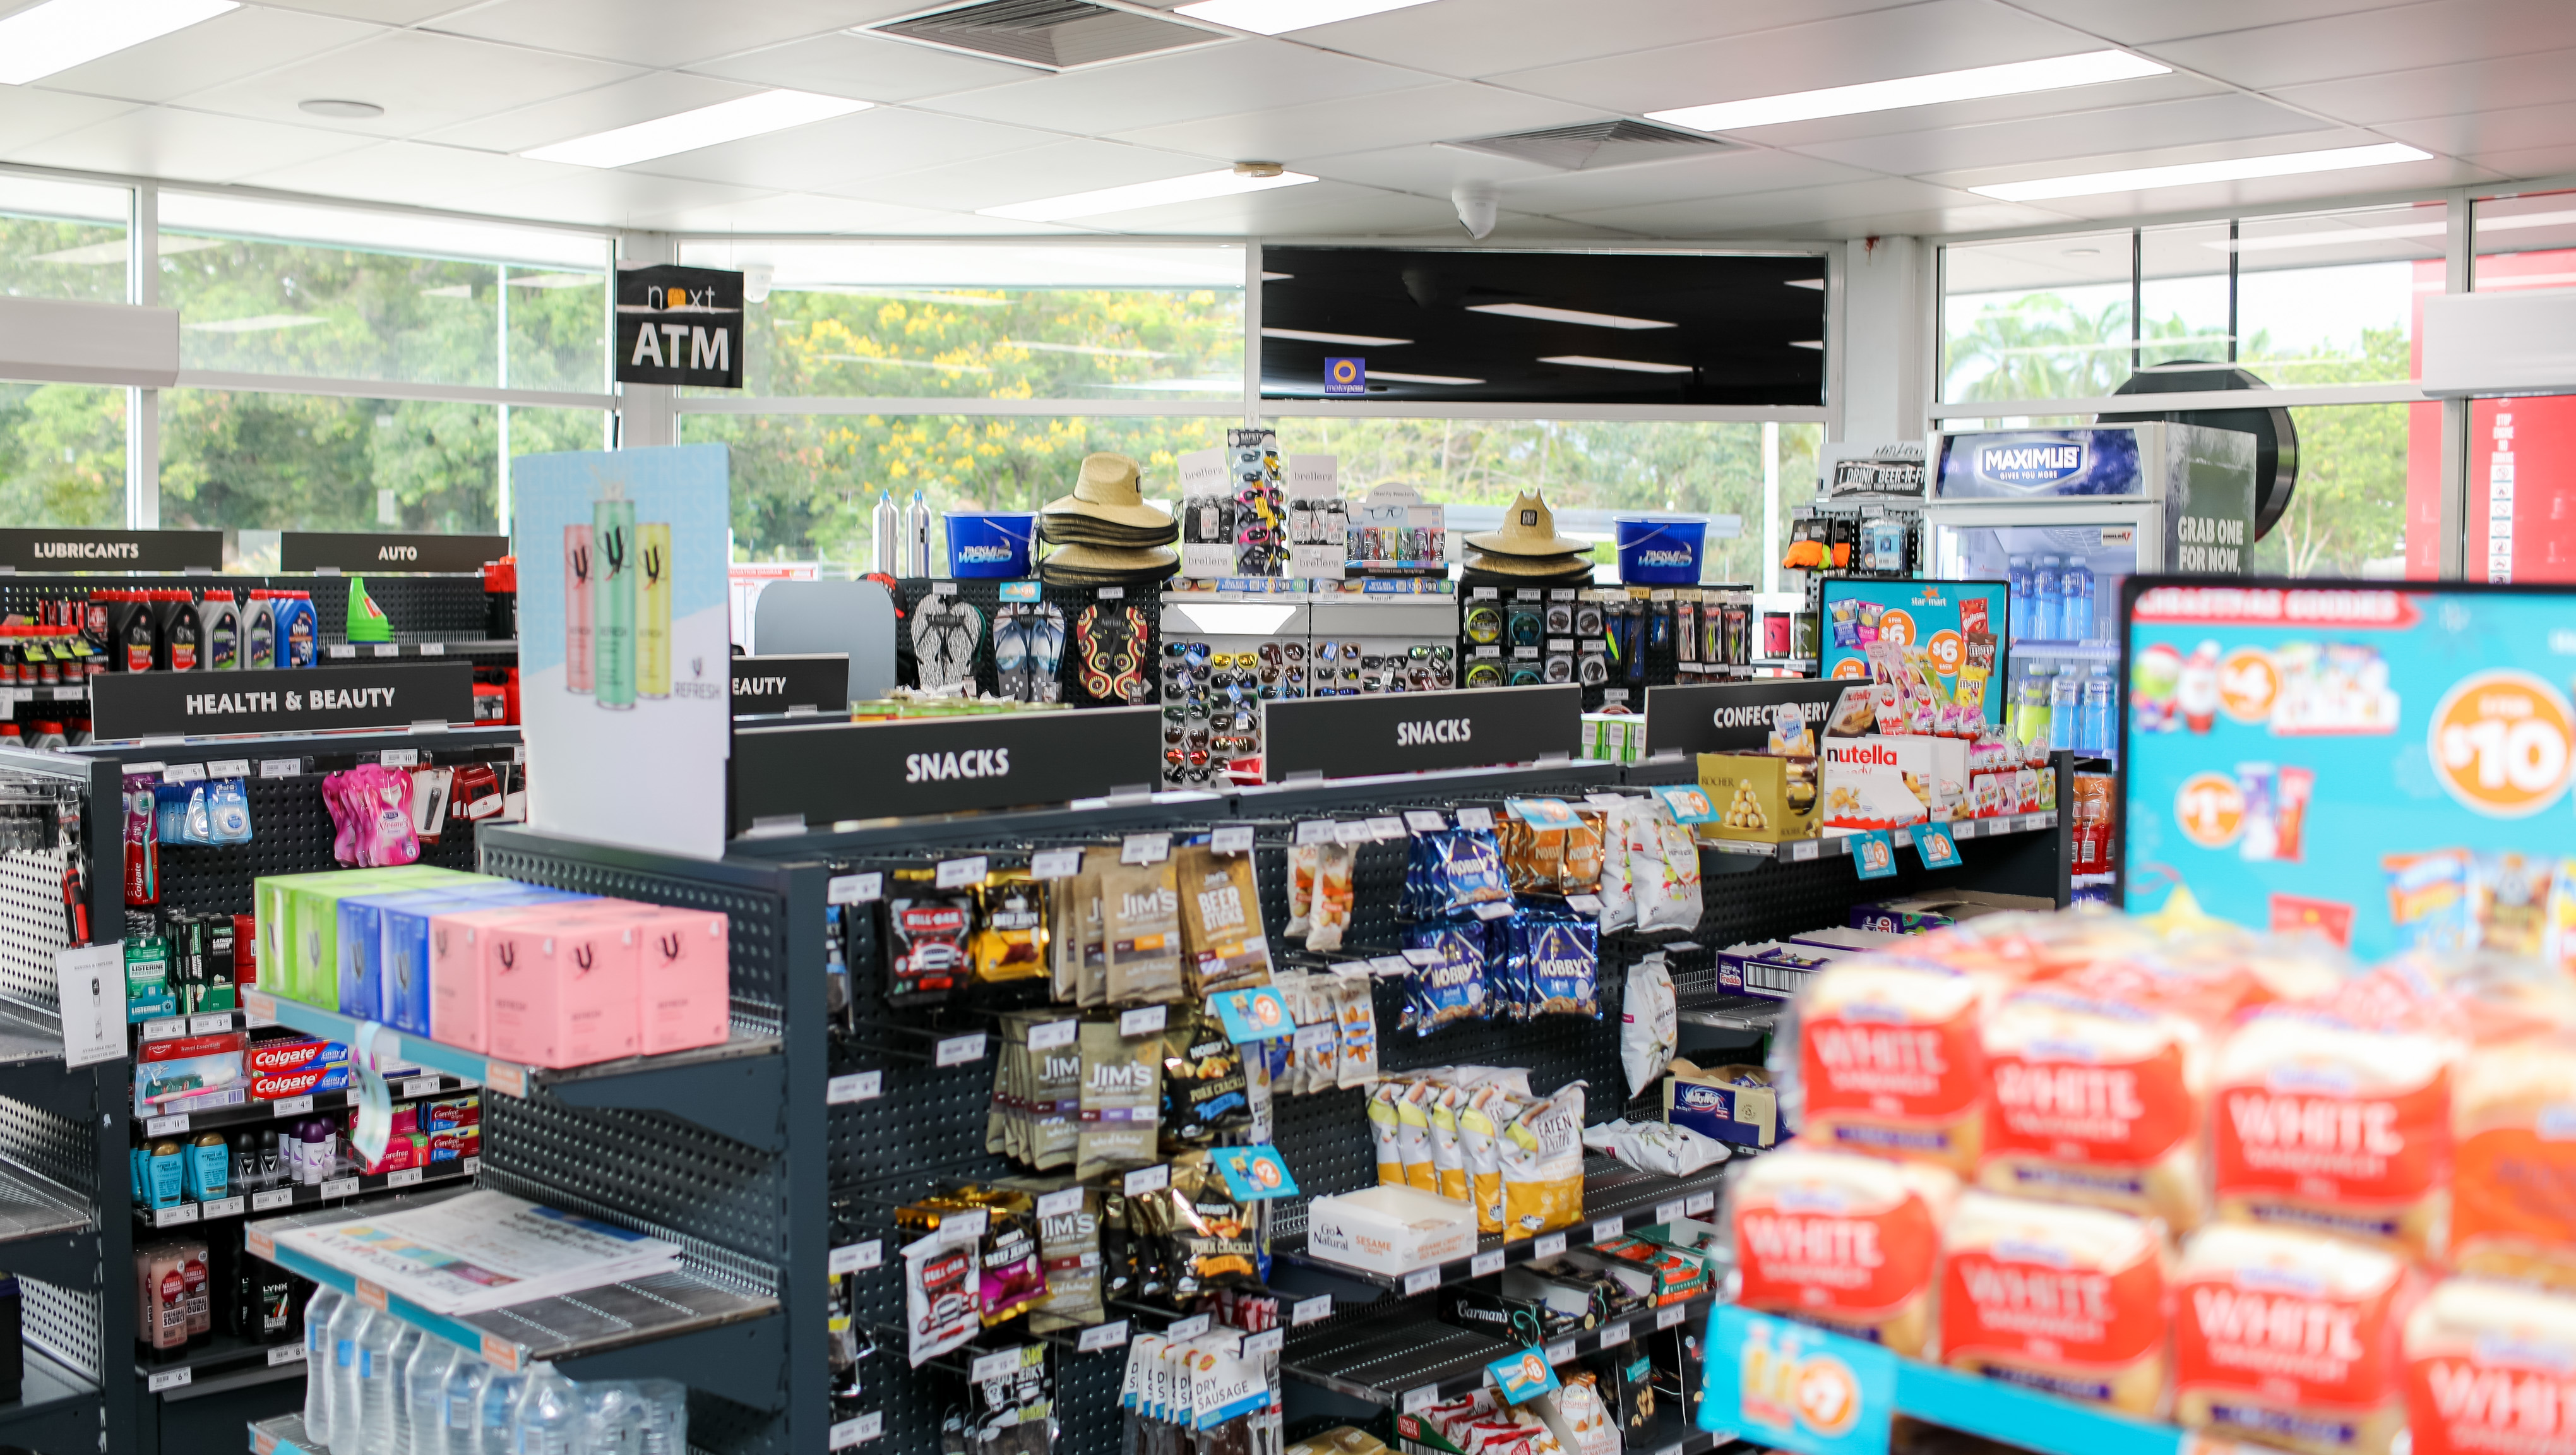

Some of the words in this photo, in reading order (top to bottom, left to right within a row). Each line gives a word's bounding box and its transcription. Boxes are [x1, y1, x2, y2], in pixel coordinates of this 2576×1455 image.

[648, 285, 715, 314] nxt
[631, 322, 729, 371] ATM
[2496, 414, 2512, 426] STOP
[1985, 447, 2080, 472] MAXIMUS
[1846, 468, 1875, 484] DRINK
[2000, 472, 2020, 480] GIVES
[2022, 471, 2036, 479] YOU
[2037, 470, 2058, 479] MORE
[2178, 516, 2214, 544] GRAB
[2217, 519, 2244, 546] ONE
[34, 542, 139, 560] LUBRICANTS
[378, 546, 417, 561] AUTO
[958, 551, 1012, 563] WORLD
[2179, 546, 2206, 571] FOR
[2209, 546, 2241, 575] NOW,
[1911, 597, 1925, 606] star
[1928, 597, 1947, 607] mart
[293, 623, 309, 633] Delo
[1881, 624, 1905, 646] $6
[1933, 638, 1958, 662] $6
[732, 676, 787, 695] EAUTY
[186, 692, 277, 715] HEALTH
[285, 691, 302, 711] &
[309, 687, 395, 710] BEAUTY
[1714, 702, 1830, 728] CONFECTERY
[1396, 718, 1472, 746] SNACKS
[1827, 743, 1897, 766] nutella
[2441, 719, 2568, 792] $10
[906, 748, 1009, 782] SNACKS
[1702, 776, 1734, 788] ROCHER
[134, 863, 143, 898] Colgate
[1116, 887, 1178, 919] JIM'S
[1198, 885, 1240, 914] BEER
[131, 963, 164, 971] LISTERINE
[1432, 958, 1482, 988] NOBBY'S
[1539, 956, 1590, 977] NOBBY'S
[1719, 974, 1741, 986] Freddo
[131, 1004, 161, 1014] LISTERINE
[148, 1043, 172, 1051] Colgate
[256, 1047, 317, 1067] Colgate
[1039, 1055, 1080, 1081] JIM
[1085, 1060, 1153, 1089] JIM'S
[256, 1074, 317, 1093] Colgate
[434, 1109, 459, 1118] Carefree
[2228, 1093, 2404, 1154] WHITE
[1538, 1114, 1572, 1138] EATEN
[434, 1138, 460, 1148] Carefree
[1041, 1211, 1096, 1239] JIM'S
[1321, 1223, 1335, 1236] Go
[1314, 1231, 1349, 1251] Natural
[1356, 1235, 1392, 1252] SESAME
[1744, 1214, 1884, 1267] WHITE
[162, 1281, 181, 1290] VANILLA
[924, 1269, 946, 1283] BULL
[263, 1283, 287, 1293] LYNX
[163, 1307, 184, 1320] ORIGINAL
[187, 1304, 207, 1314] OURCE
[1457, 1300, 1508, 1323] Carman's
[164, 1315, 185, 1327] SOURCE
[2193, 1286, 2362, 1362] WHITE
[1196, 1377, 1217, 1395] DRY
[1198, 1380, 1249, 1411] SAUSAGE
[2428, 1360, 2576, 1433] WHIT
[1399, 1418, 1417, 1428] UNCLE
